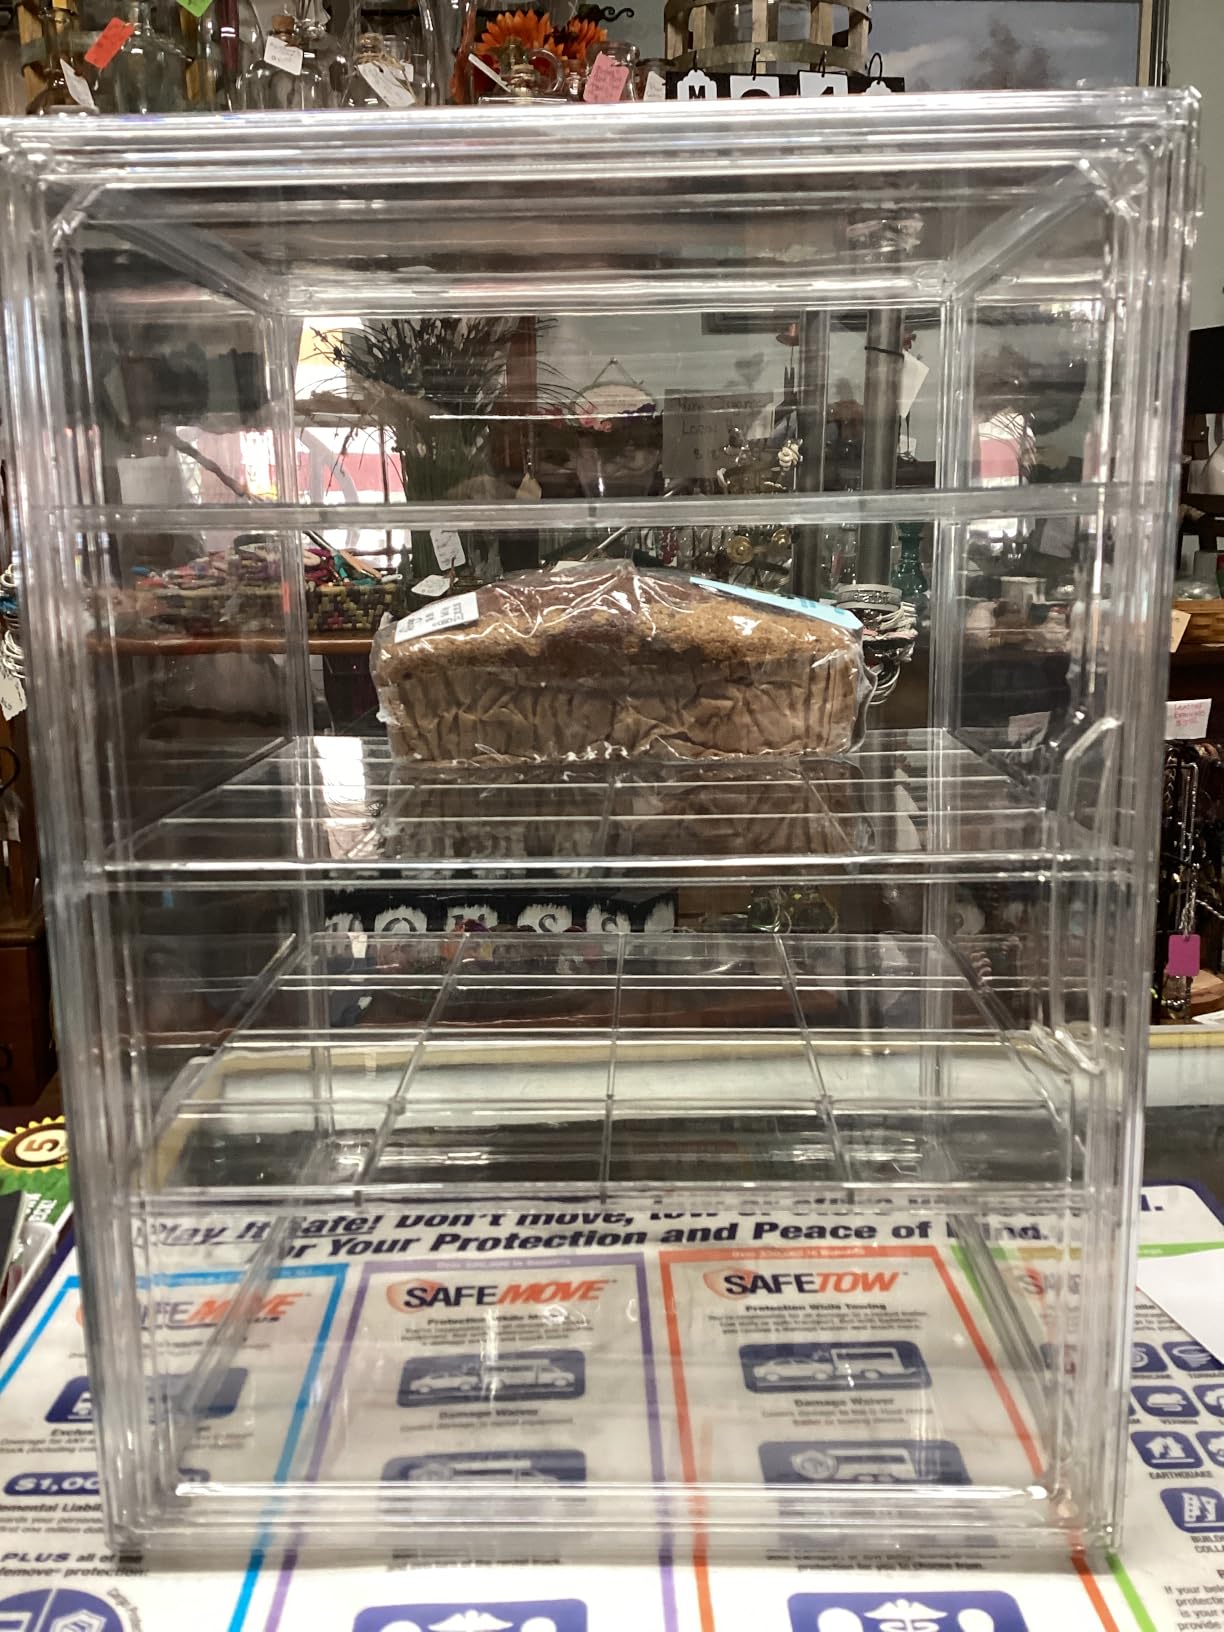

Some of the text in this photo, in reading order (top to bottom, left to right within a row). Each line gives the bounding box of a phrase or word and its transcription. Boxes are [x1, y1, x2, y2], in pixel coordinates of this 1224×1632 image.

[290, 1213, 382, 1236] afe!
[394, 1212, 506, 1229] Don't
[515, 1212, 635, 1228] move,
[328, 1236, 421, 1257] Your
[429, 1230, 648, 1252] Protection
[660, 1222, 740, 1244] and
[753, 1221, 878, 1240] Peace
[891, 1220, 932, 1240] of
[403, 1279, 609, 1308] SAFEMOVE
[723, 1271, 899, 1295] SAFETOW
[1, 1552, 71, 1563] PLUS
